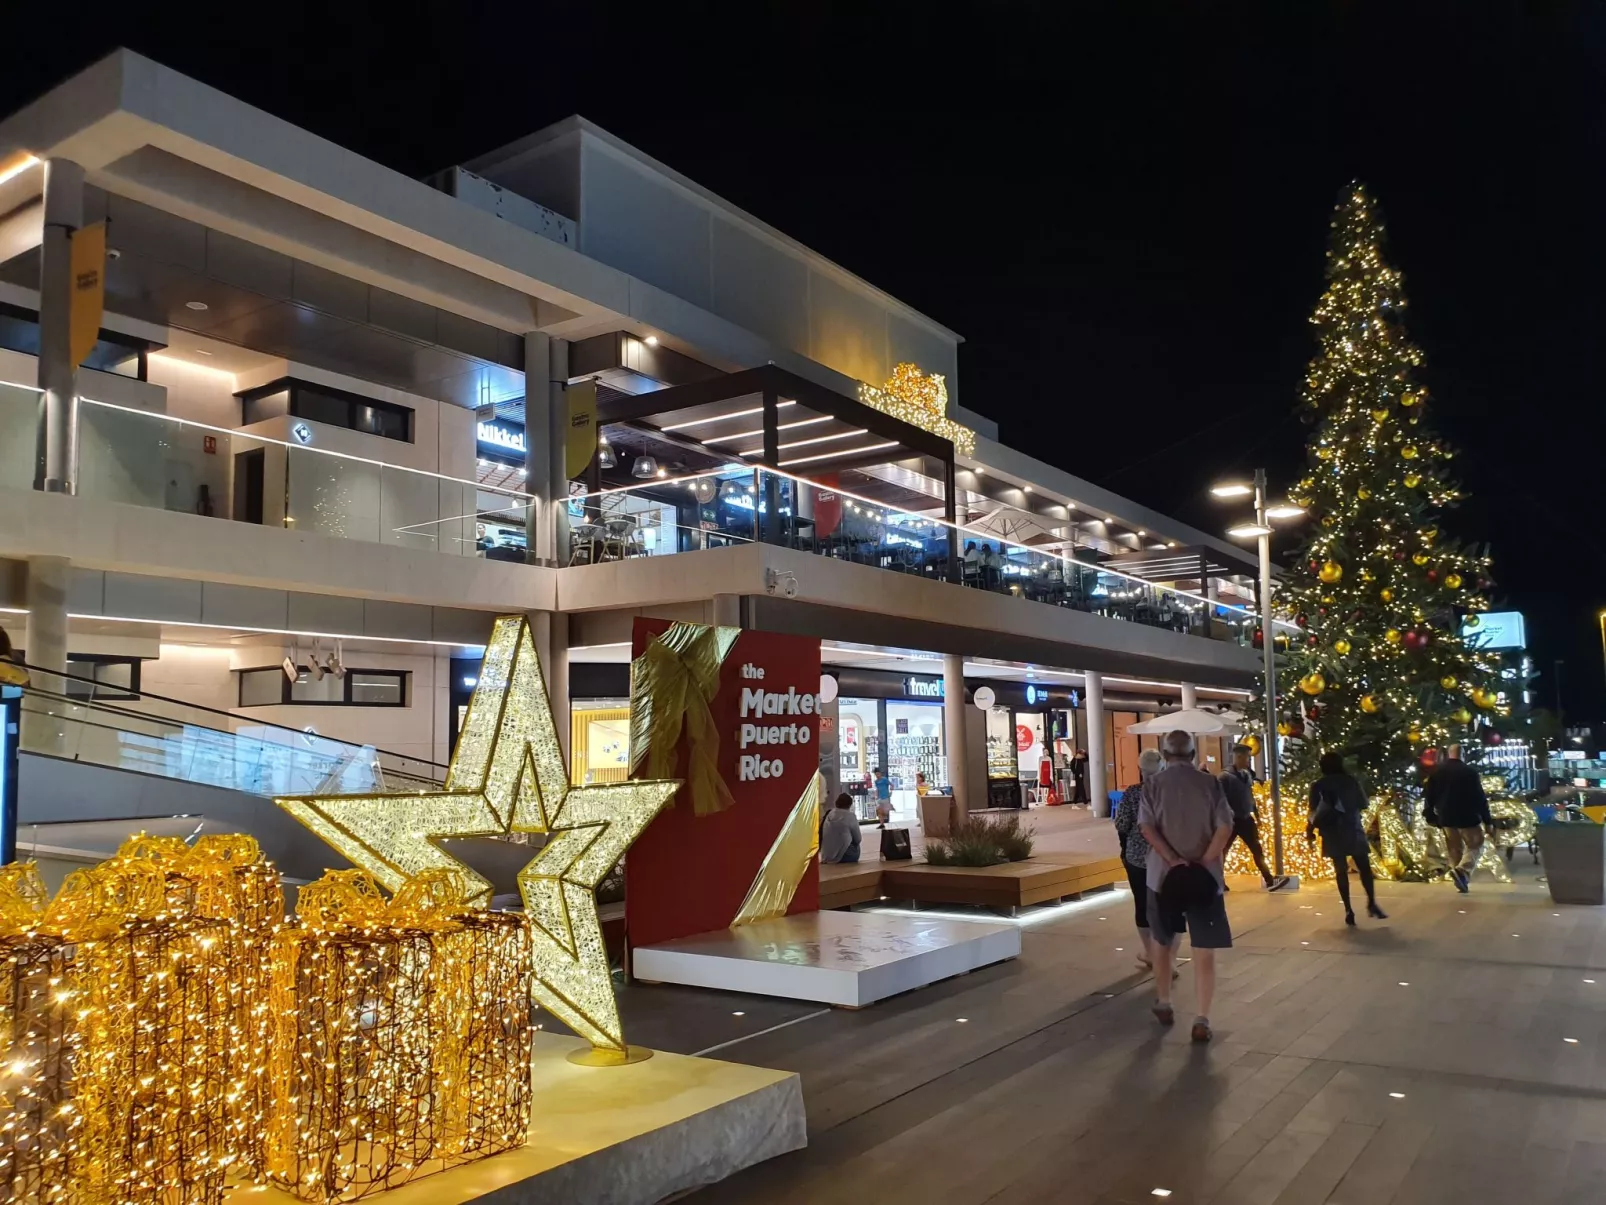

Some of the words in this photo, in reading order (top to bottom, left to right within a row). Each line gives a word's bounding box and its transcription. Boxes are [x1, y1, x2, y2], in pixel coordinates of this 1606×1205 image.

[741, 662, 765, 680] the
[740, 686, 821, 718] Market
[740, 723, 811, 750] Puerto
[739, 754, 784, 782] Rico
